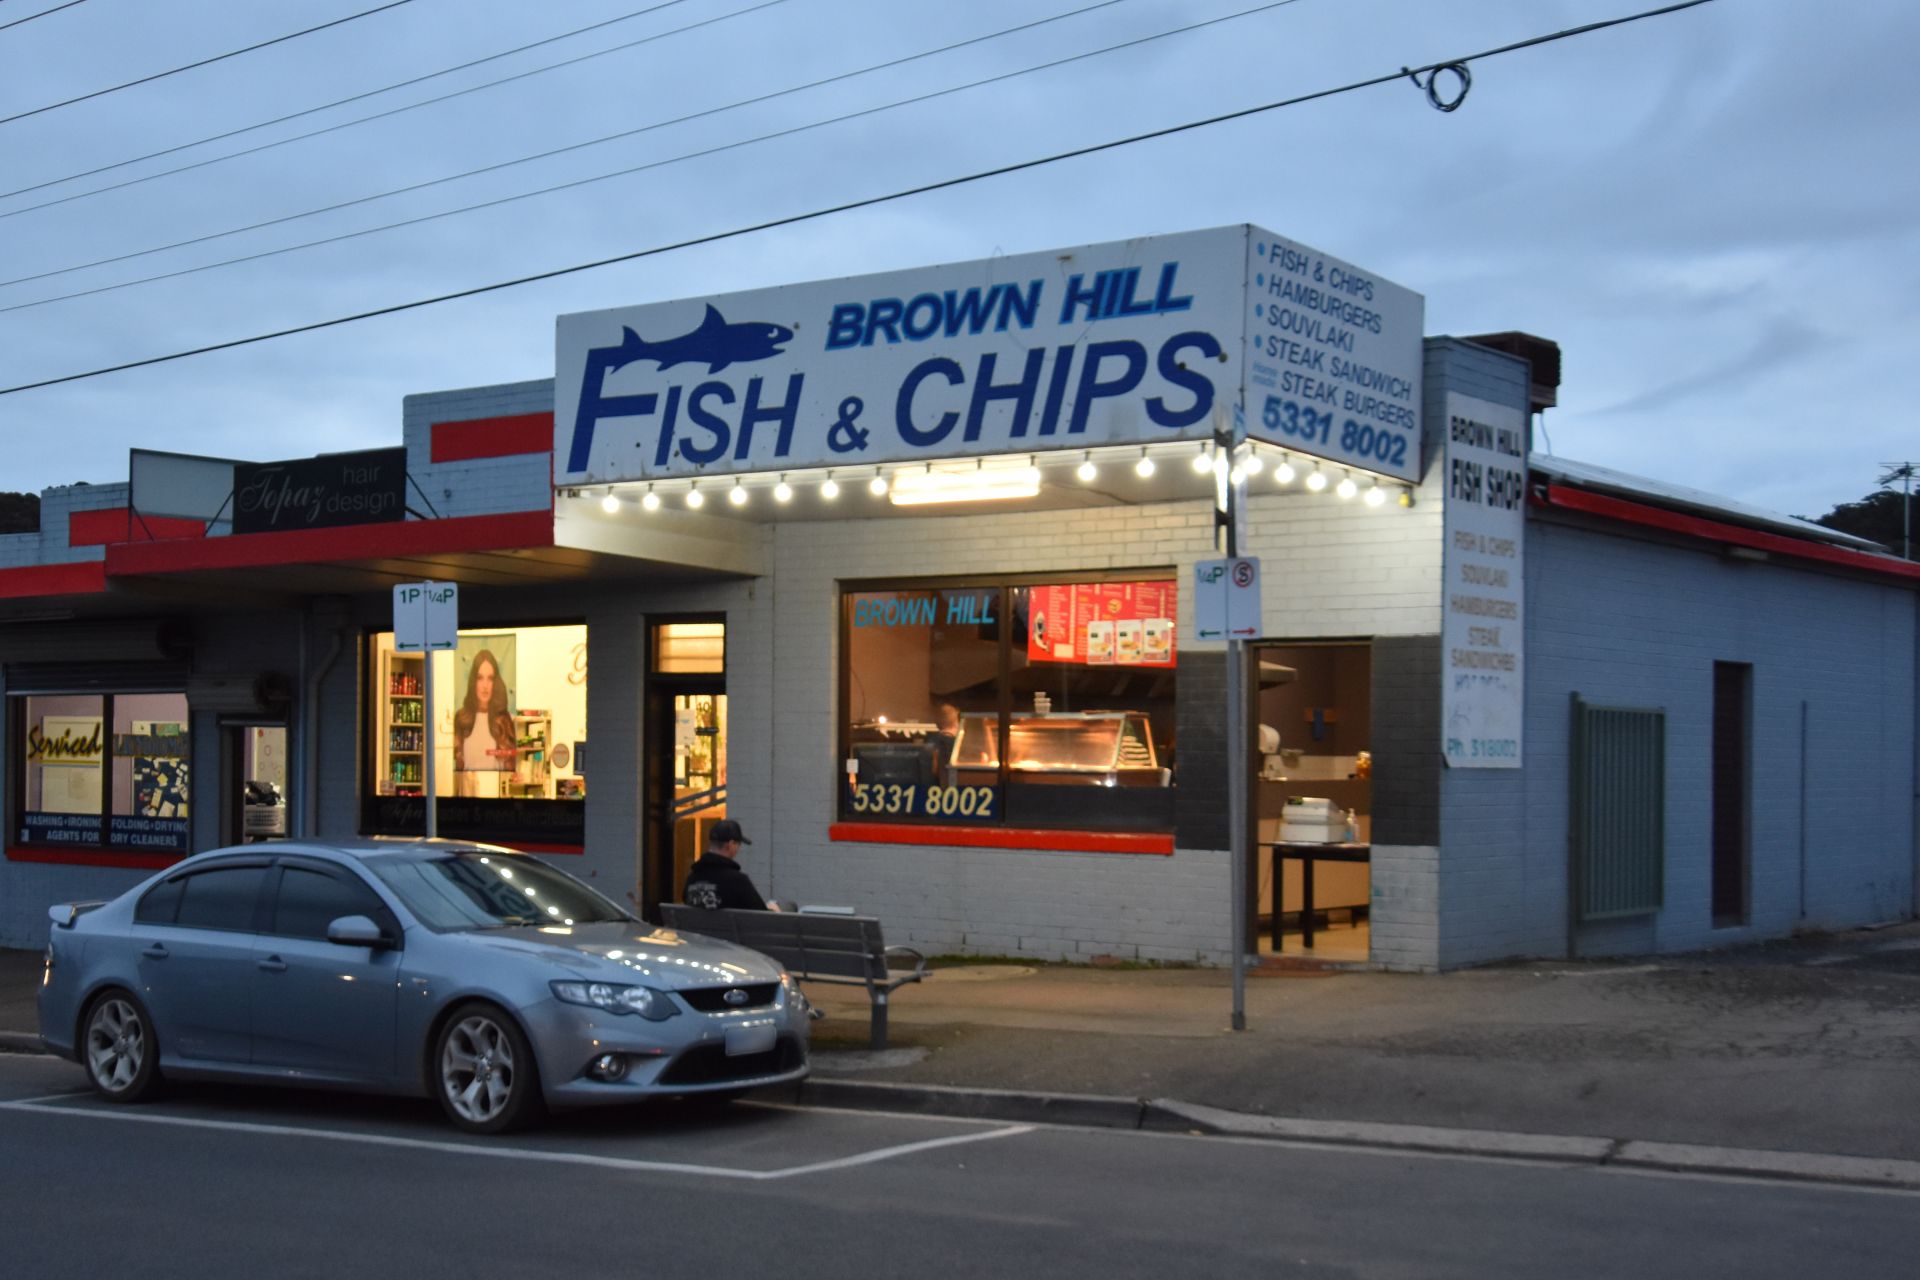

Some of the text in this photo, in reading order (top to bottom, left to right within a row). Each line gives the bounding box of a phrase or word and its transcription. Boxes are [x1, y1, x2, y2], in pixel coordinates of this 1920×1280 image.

[1269, 243, 1374, 301] FISH & CHIPS
[824, 261, 1195, 351] BROWN HILL
[1267, 304, 1355, 353] SOUVLAKI
[1268, 274, 1382, 334] HAMBURGERS
[1266, 335, 1412, 401] STEAK SANDWICH
[567, 330, 1222, 473] FISH & CHIPS
[1281, 370, 1415, 430] STEAK BURGERS
[1262, 394, 1408, 468] 5331 8002
[1451, 415, 1521, 458] BROWN HILL
[238, 467, 325, 525] Topaz
[343, 464, 381, 486] hair
[1452, 459, 1522, 511] FISH SHOP
[326, 488, 396, 514] design
[400, 588, 420, 604] 1P
[854, 595, 995, 627] BROWN HILL
[28, 722, 103, 759] Serviced
[111, 818, 150, 831] FOLDING
[854, 784, 994, 816] 5331 8002
[46, 830, 177, 847] AGENTS FOR DRY CLEANERS
